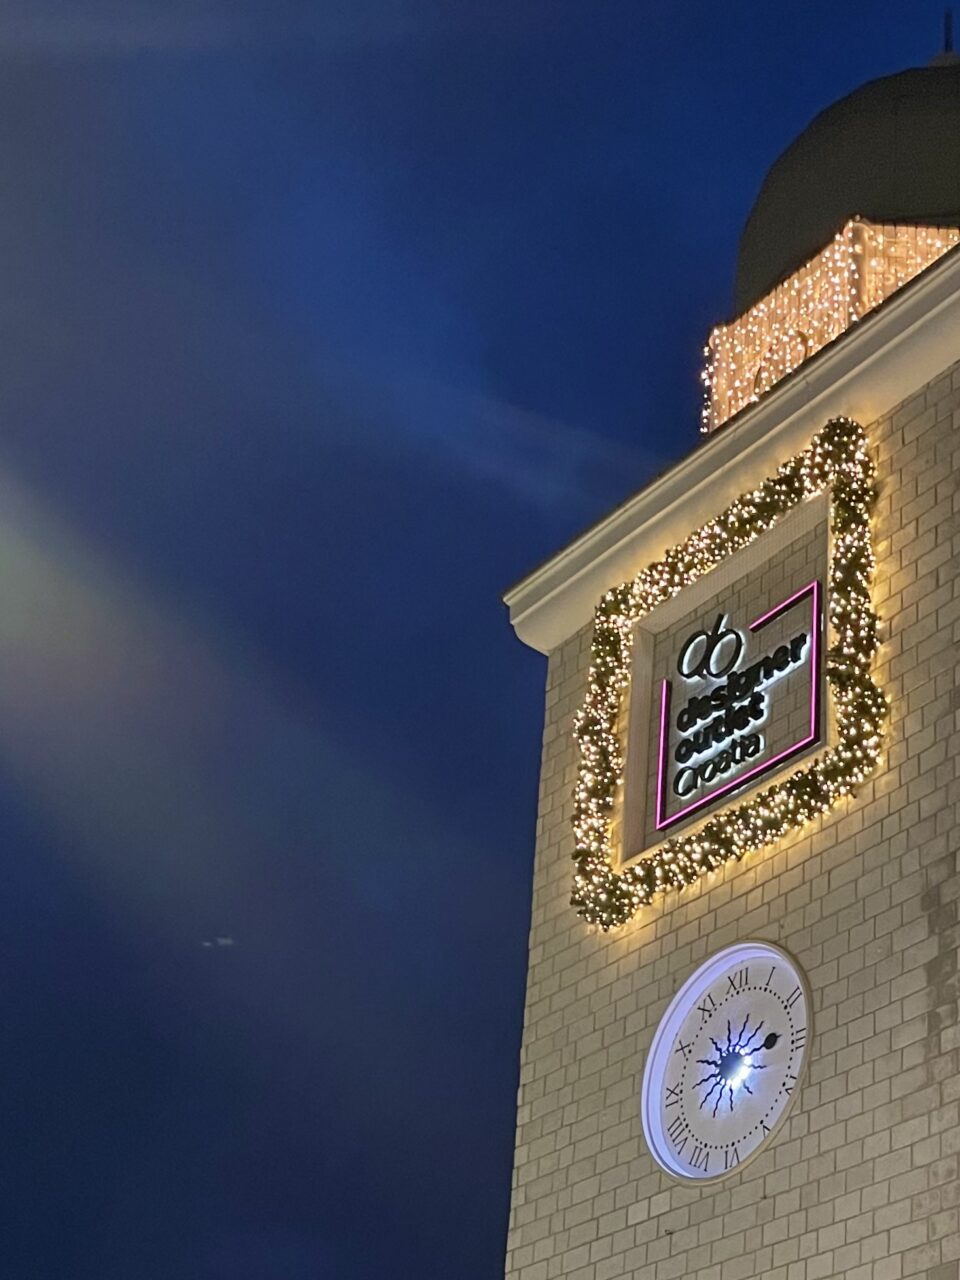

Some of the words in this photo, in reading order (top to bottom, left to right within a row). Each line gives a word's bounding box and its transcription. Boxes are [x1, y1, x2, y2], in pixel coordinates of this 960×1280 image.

[677, 632, 808, 733] designer
[674, 691, 766, 764] outlet
[673, 733, 765, 797] Croatia
[726, 967, 748, 995] XII
[766, 967, 776, 986] I
[697, 994, 717, 1020] XI
[786, 986, 803, 1009] II
[675, 1039, 691, 1057] X
[795, 1028, 807, 1051] III
[665, 1083, 680, 1108] IX
[667, 1116, 687, 1155] VIII
[689, 1146, 710, 1172] VII
